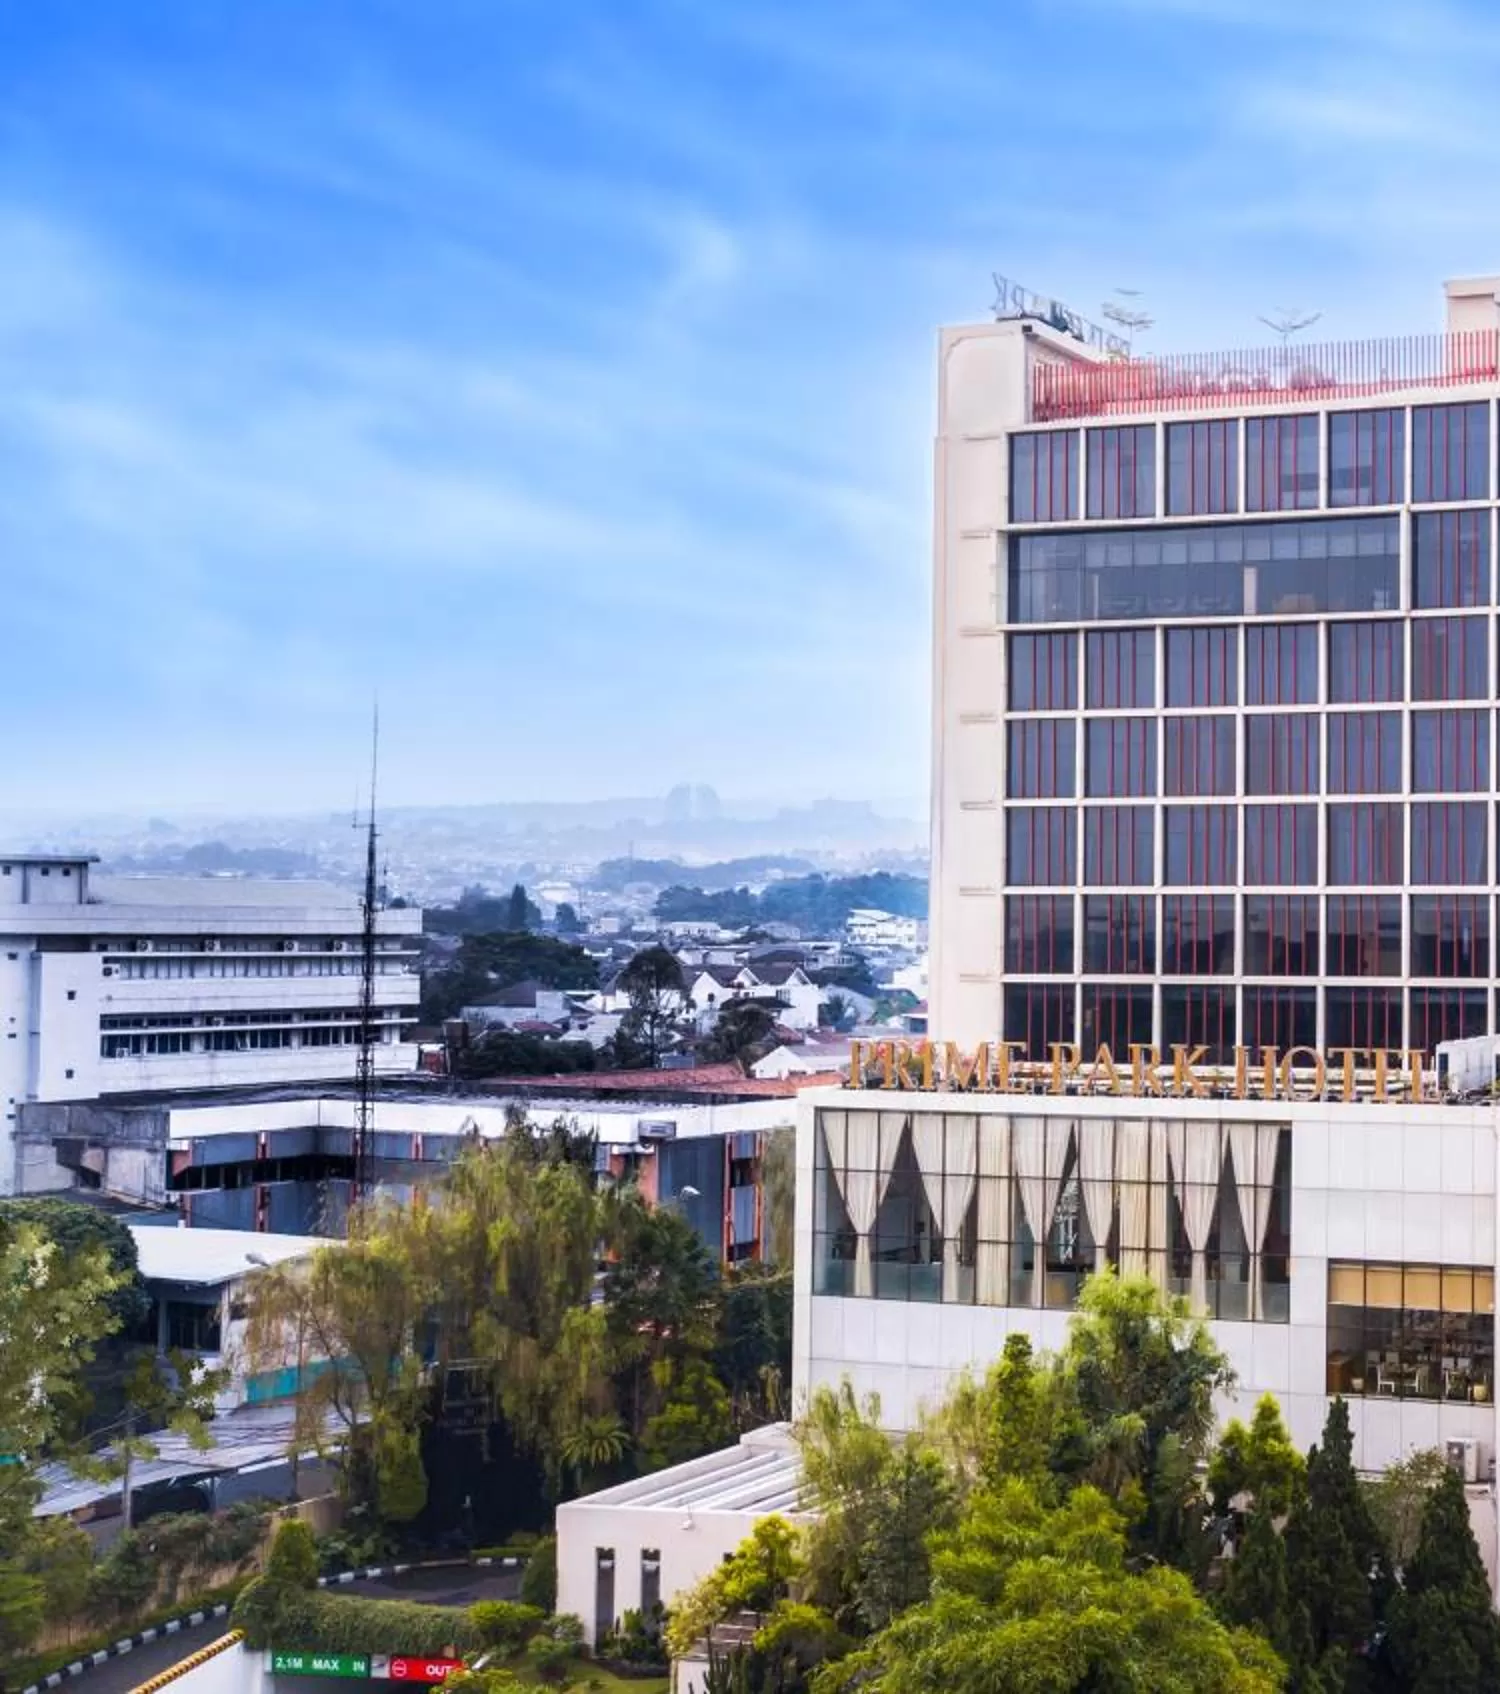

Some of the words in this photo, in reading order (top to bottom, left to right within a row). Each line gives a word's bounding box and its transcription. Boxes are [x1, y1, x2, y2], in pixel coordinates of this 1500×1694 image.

[847, 1040, 1029, 1092] PRIME
[1047, 1042, 1211, 1097] PARK
[1232, 1045, 1440, 1103] HOTEL
[312, 1658, 339, 1671] MAX
[352, 1660, 365, 1673] IN
